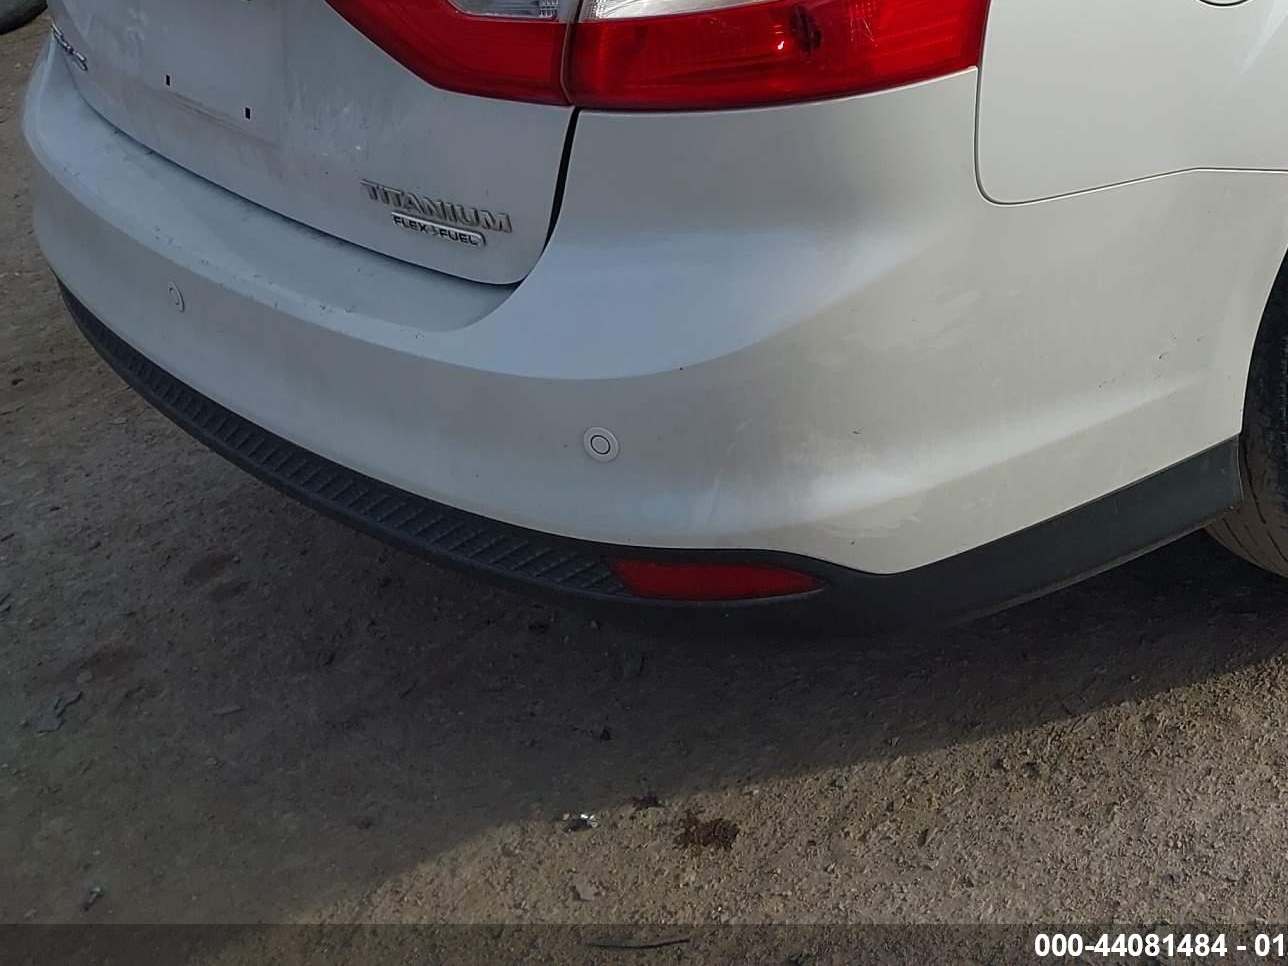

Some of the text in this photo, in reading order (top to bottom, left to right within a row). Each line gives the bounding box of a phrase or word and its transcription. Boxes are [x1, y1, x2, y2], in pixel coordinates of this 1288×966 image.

[360, 179, 513, 233] TITANIUM
[393, 215, 480, 247] FLEX FUEL
